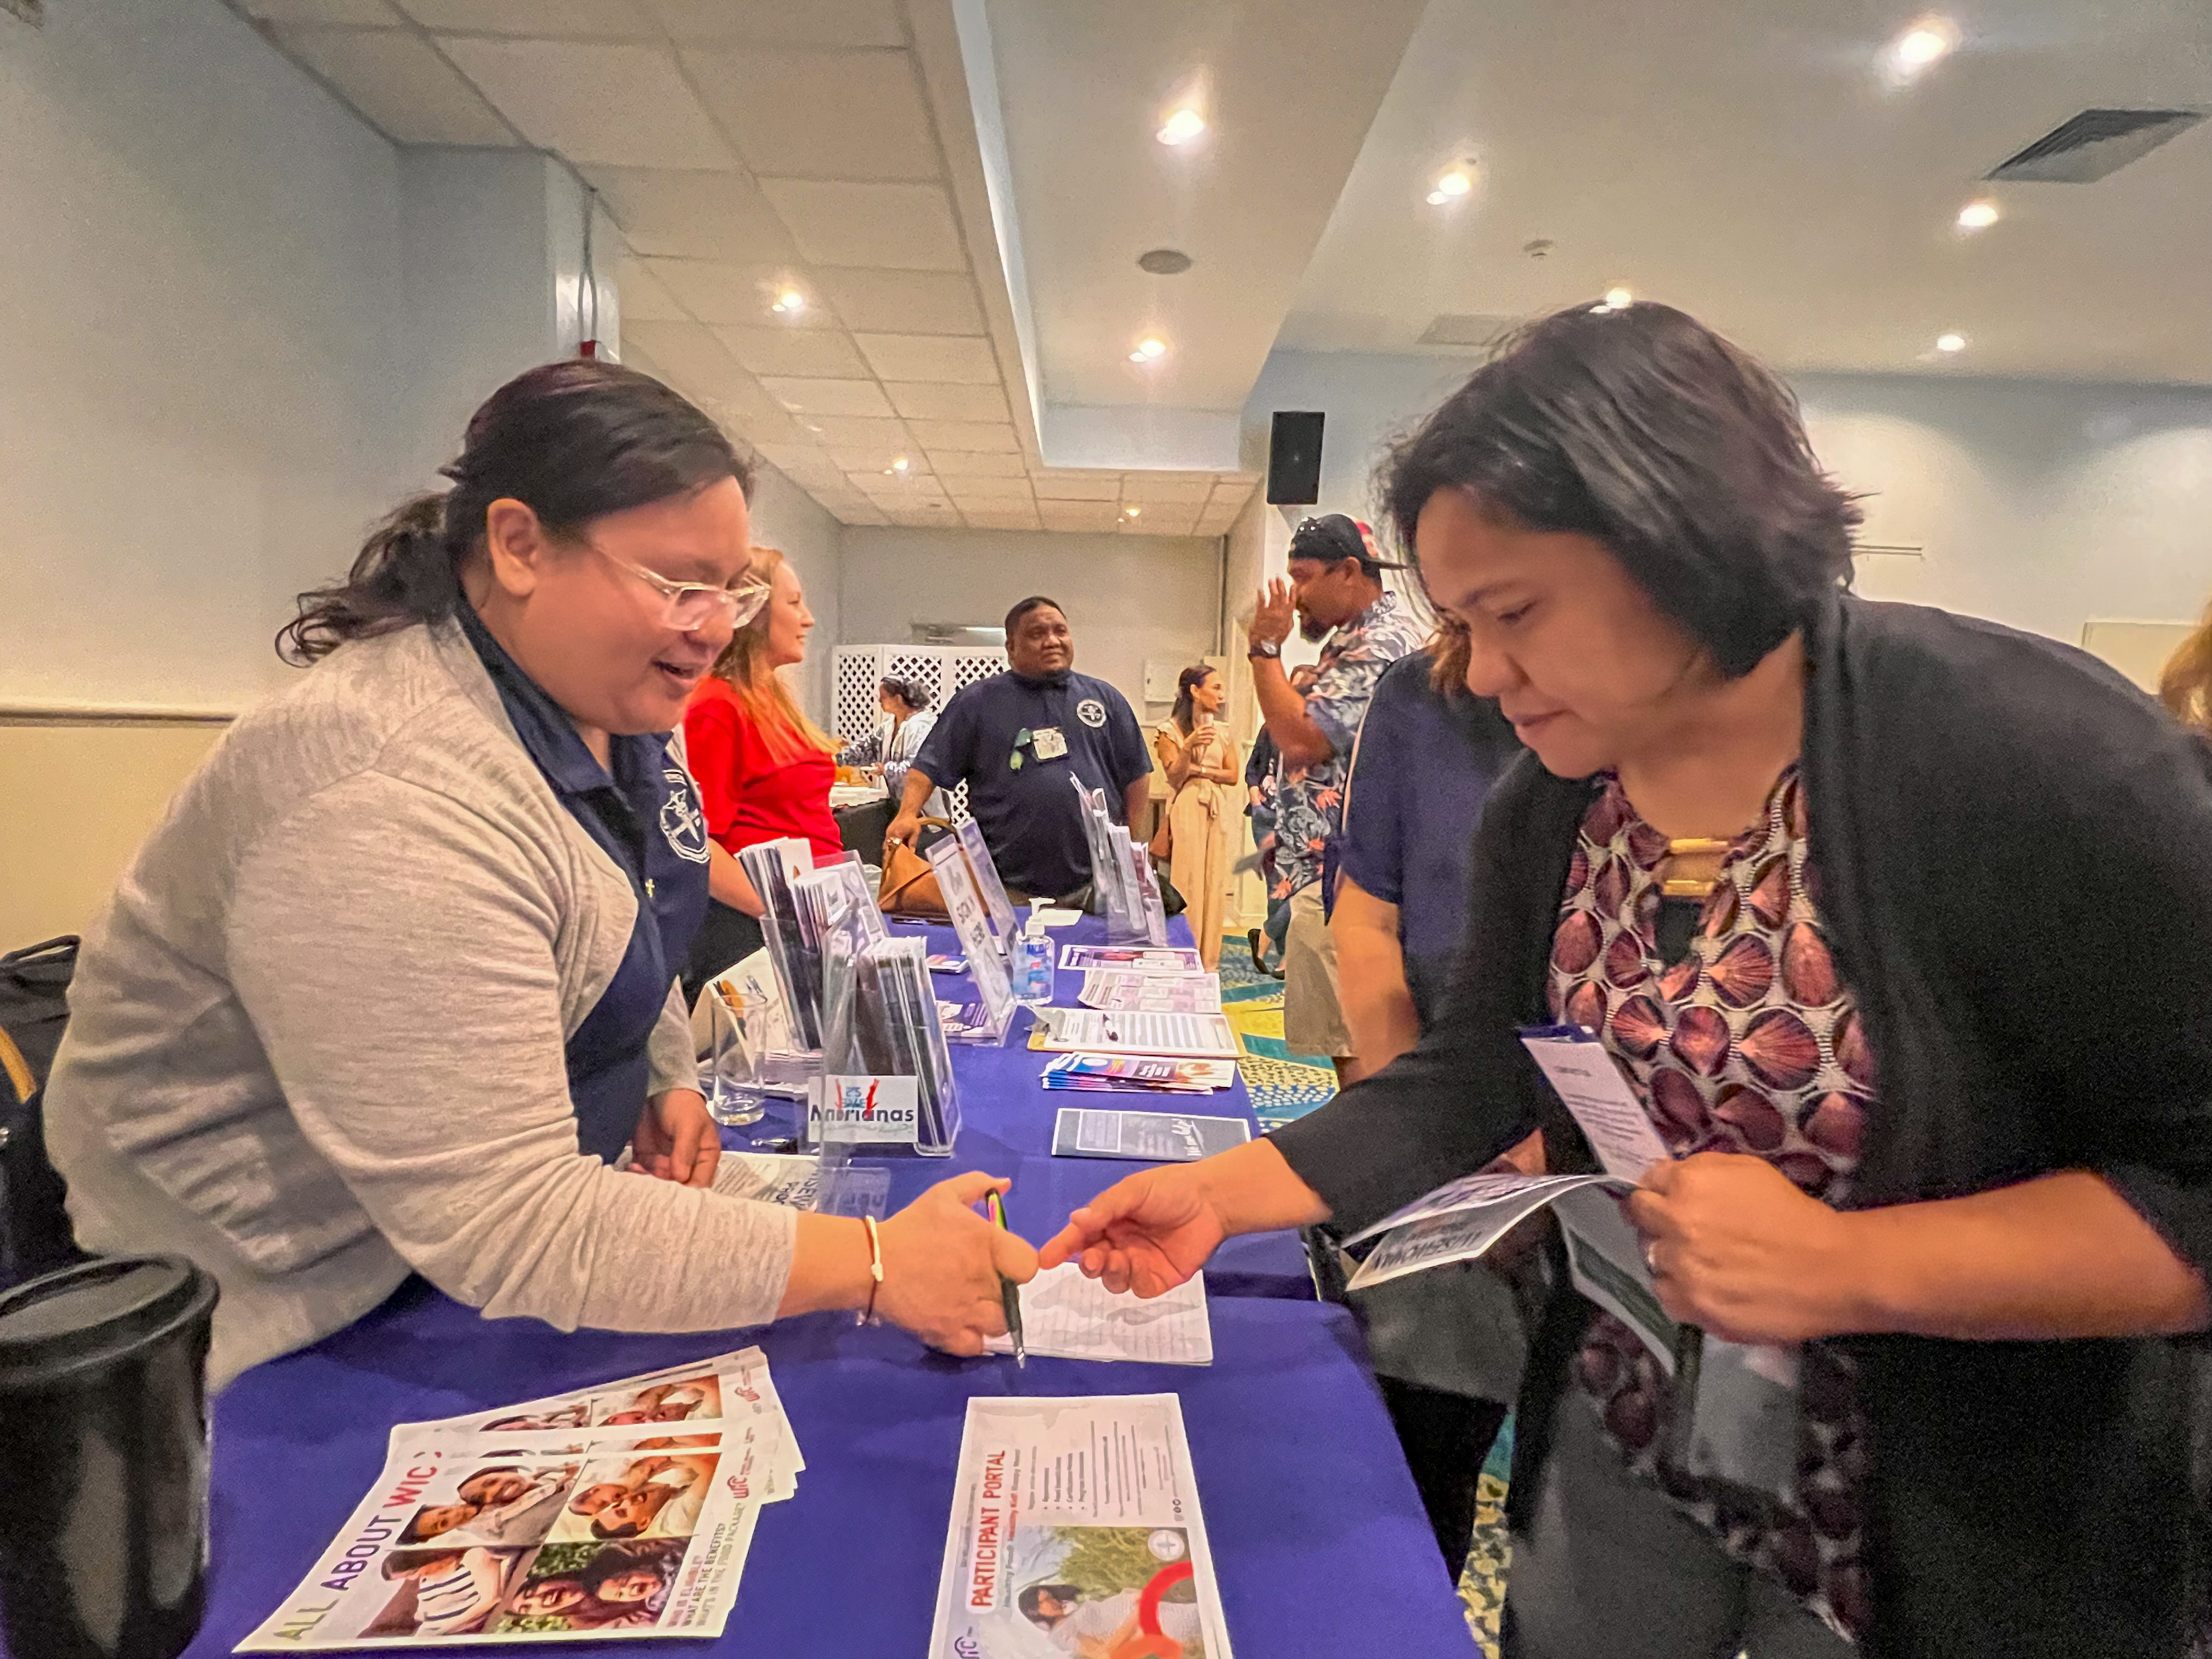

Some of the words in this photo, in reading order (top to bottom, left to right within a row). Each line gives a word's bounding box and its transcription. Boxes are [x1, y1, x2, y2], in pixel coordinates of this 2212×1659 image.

[982, 1450, 1006, 1499] PORTAL
[273, 1599, 340, 1640] ALL
[320, 1514, 402, 1591] ABOUT
[697, 1567, 713, 1583] THE
[970, 1506, 1000, 1607] PARTICIPANT
[691, 1585, 707, 1602] ARE
